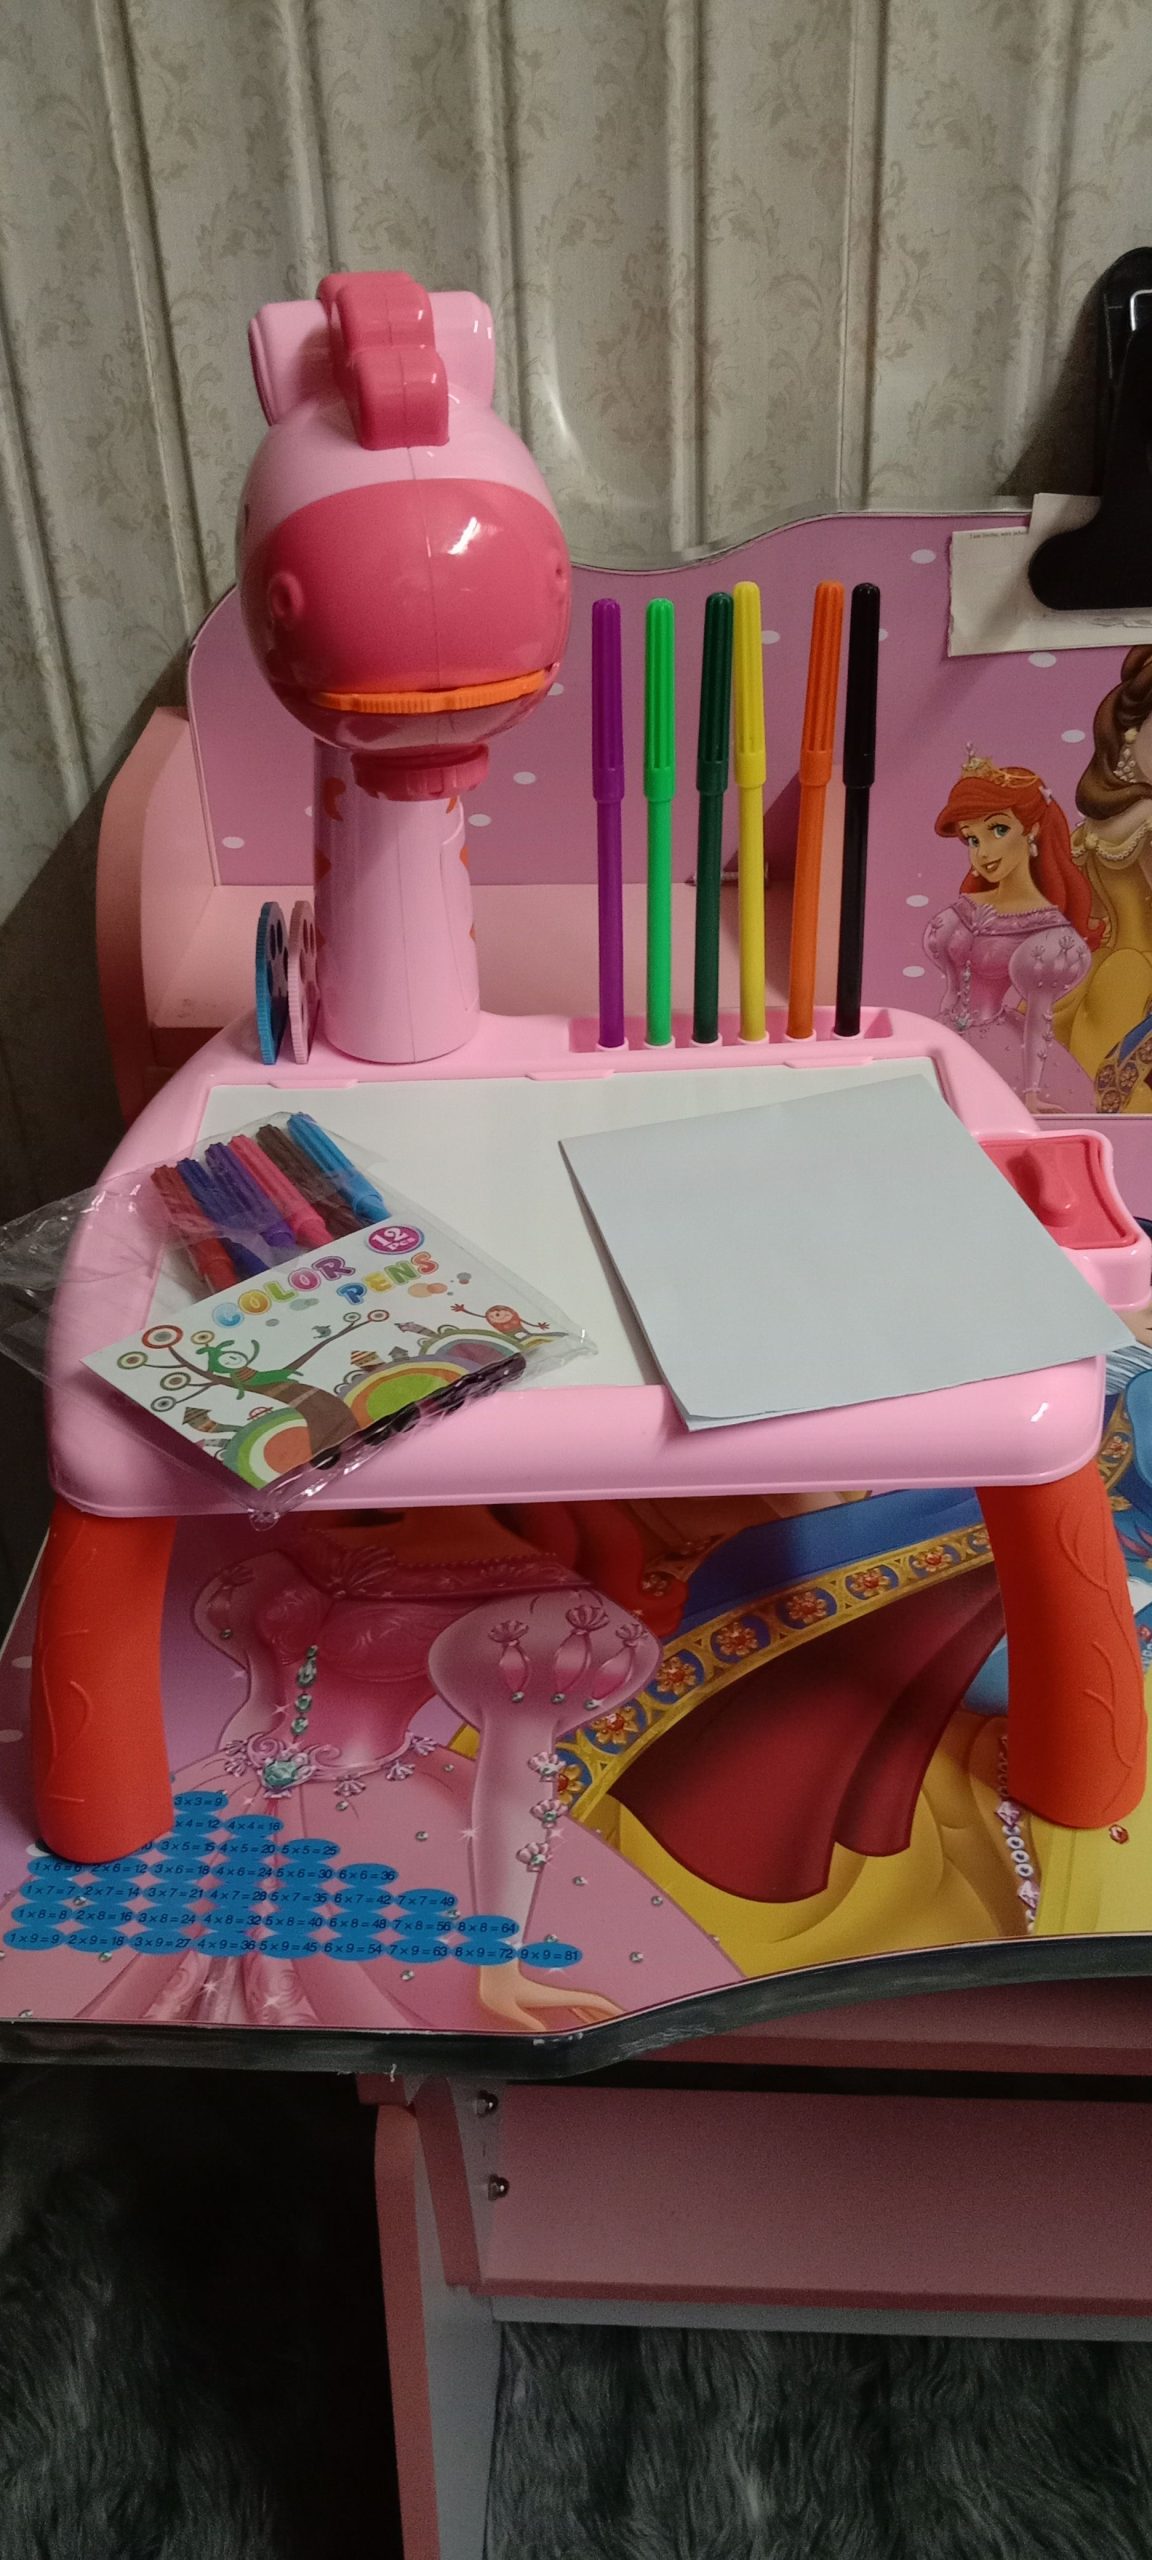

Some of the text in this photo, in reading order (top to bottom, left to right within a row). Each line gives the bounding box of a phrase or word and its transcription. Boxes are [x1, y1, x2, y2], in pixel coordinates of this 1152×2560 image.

[371, 1227, 408, 1246] 12
[211, 1255, 356, 1329] COLOR
[336, 1251, 439, 1306] PENS
